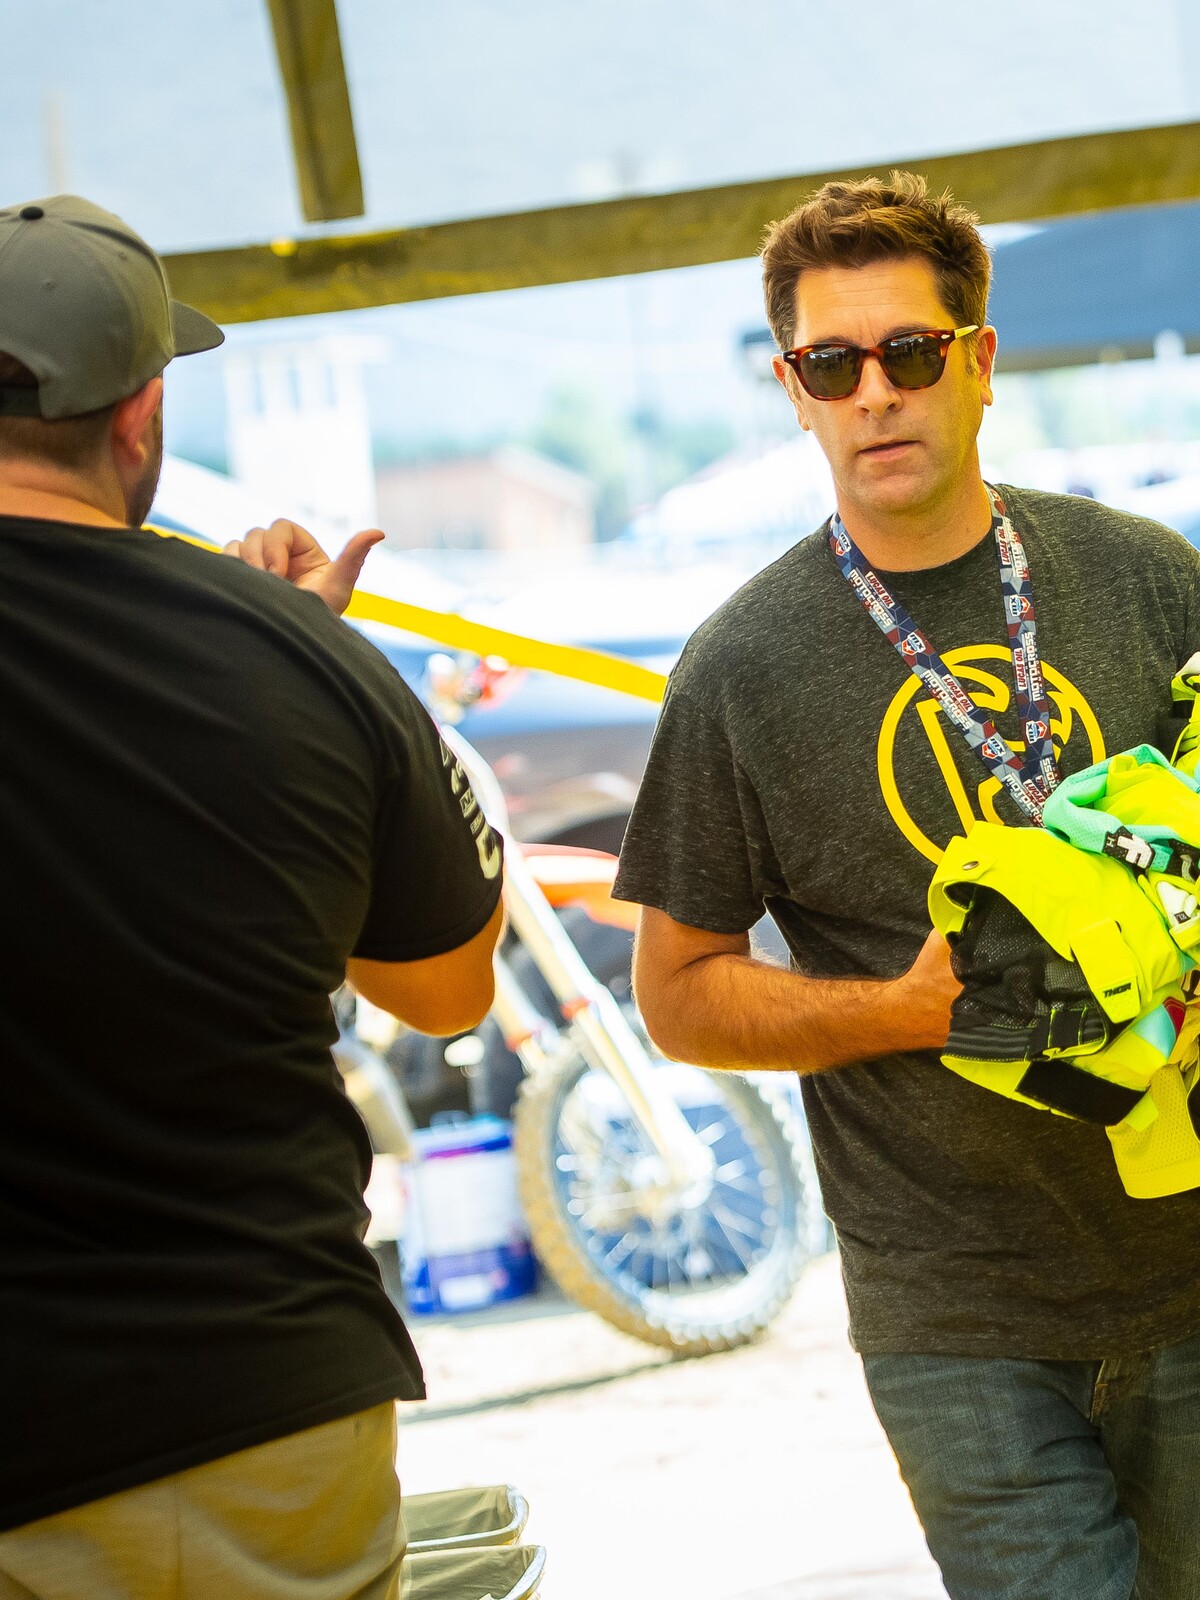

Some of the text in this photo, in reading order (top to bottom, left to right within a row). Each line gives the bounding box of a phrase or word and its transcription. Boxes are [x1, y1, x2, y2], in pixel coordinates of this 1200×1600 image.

[998, 528, 1010, 563] LUCAS OIL
[849, 569, 893, 627] MOTOCROSS
[866, 573, 893, 607] LUCAS OIL
[1015, 649, 1027, 688] LUCAS OIL
[1024, 632, 1041, 702] MOTOCROSS
[923, 670, 972, 730] MOTOCROSS
[943, 676, 973, 711] LUCAS OIL
